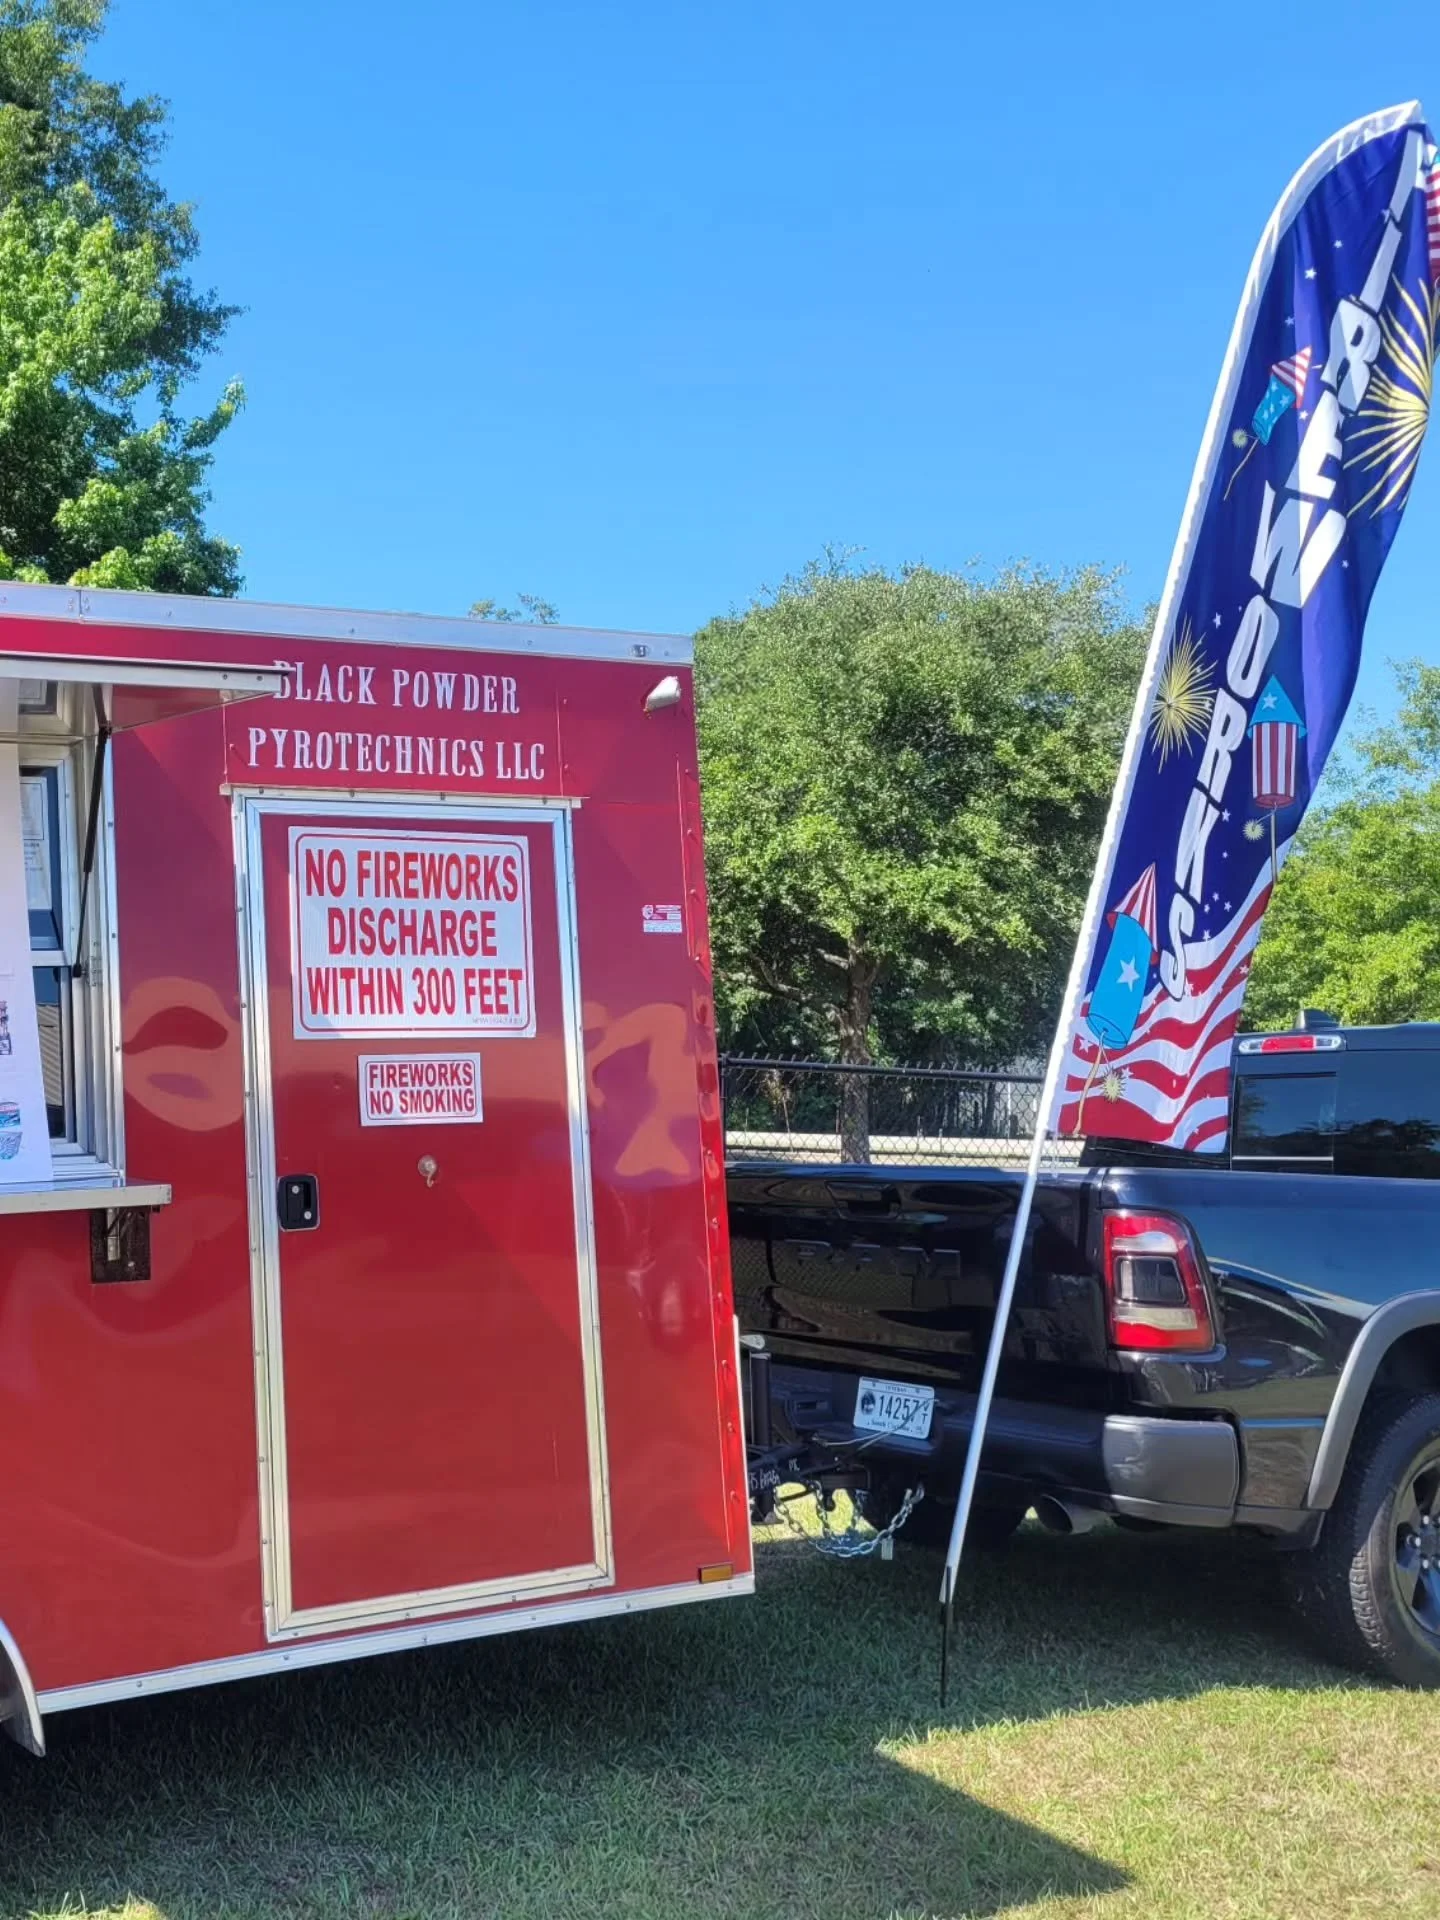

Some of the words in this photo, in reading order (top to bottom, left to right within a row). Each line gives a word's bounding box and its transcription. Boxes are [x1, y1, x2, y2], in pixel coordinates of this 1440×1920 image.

[392, 669, 520, 713] POWDER
[248, 727, 484, 777] PYROTECHNICS
[496, 741, 545, 780] LLC
[305, 848, 347, 897] NO
[357, 850, 518, 902] FIREWORKS
[327, 907, 497, 957] DISCHARGE
[307, 967, 404, 1016] WITHIN
[412, 967, 456, 1015] 300
[463, 968, 523, 1015] FEET
[369, 1062, 473, 1089] FIREWORKS
[369, 1090, 393, 1115] NO
[399, 1088, 475, 1114] SMOKING
